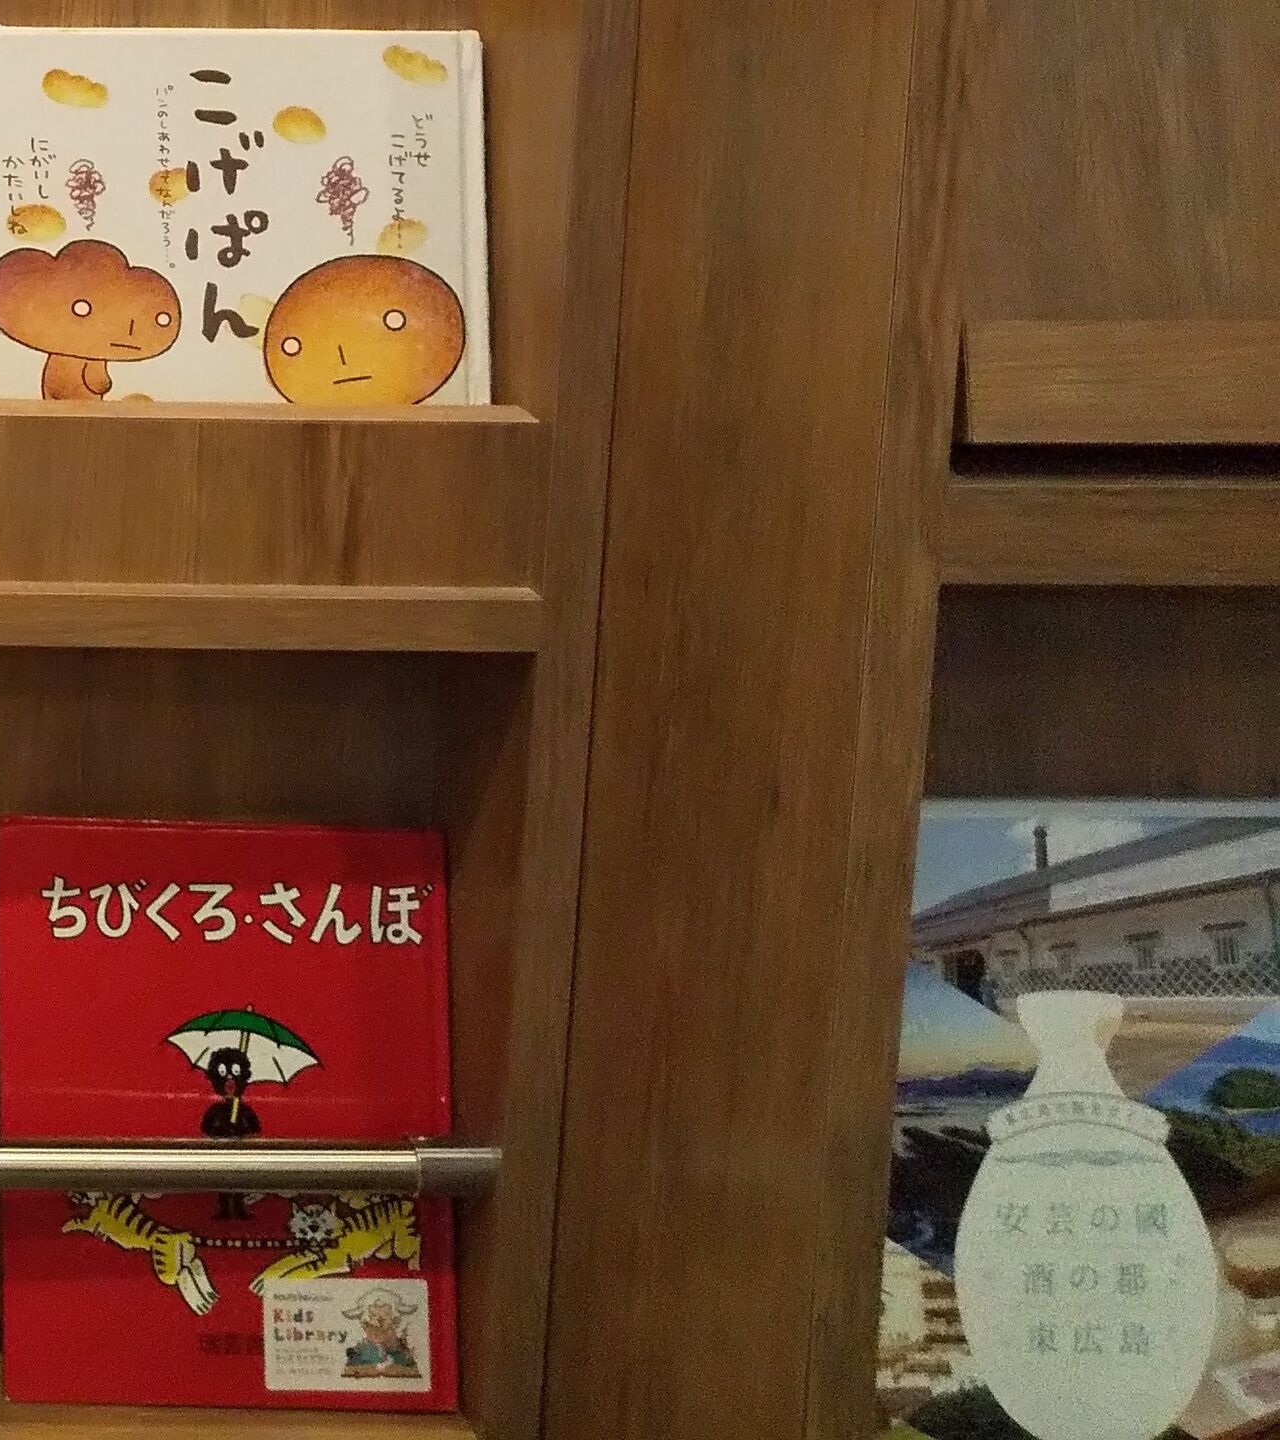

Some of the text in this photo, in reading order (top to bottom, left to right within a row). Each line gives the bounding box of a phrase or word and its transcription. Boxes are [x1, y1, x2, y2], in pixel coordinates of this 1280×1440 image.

[410, 113, 434, 168] どうせ
[29, 137, 58, 201] にがいし
[184, 68, 270, 343] こげぱん
[41, 875, 434, 945] ちびくろ・さんぼ
[272, 1308, 315, 1324] Kids
[272, 1327, 348, 1344] Library
[1025, 1323, 1151, 1357] 東広島
